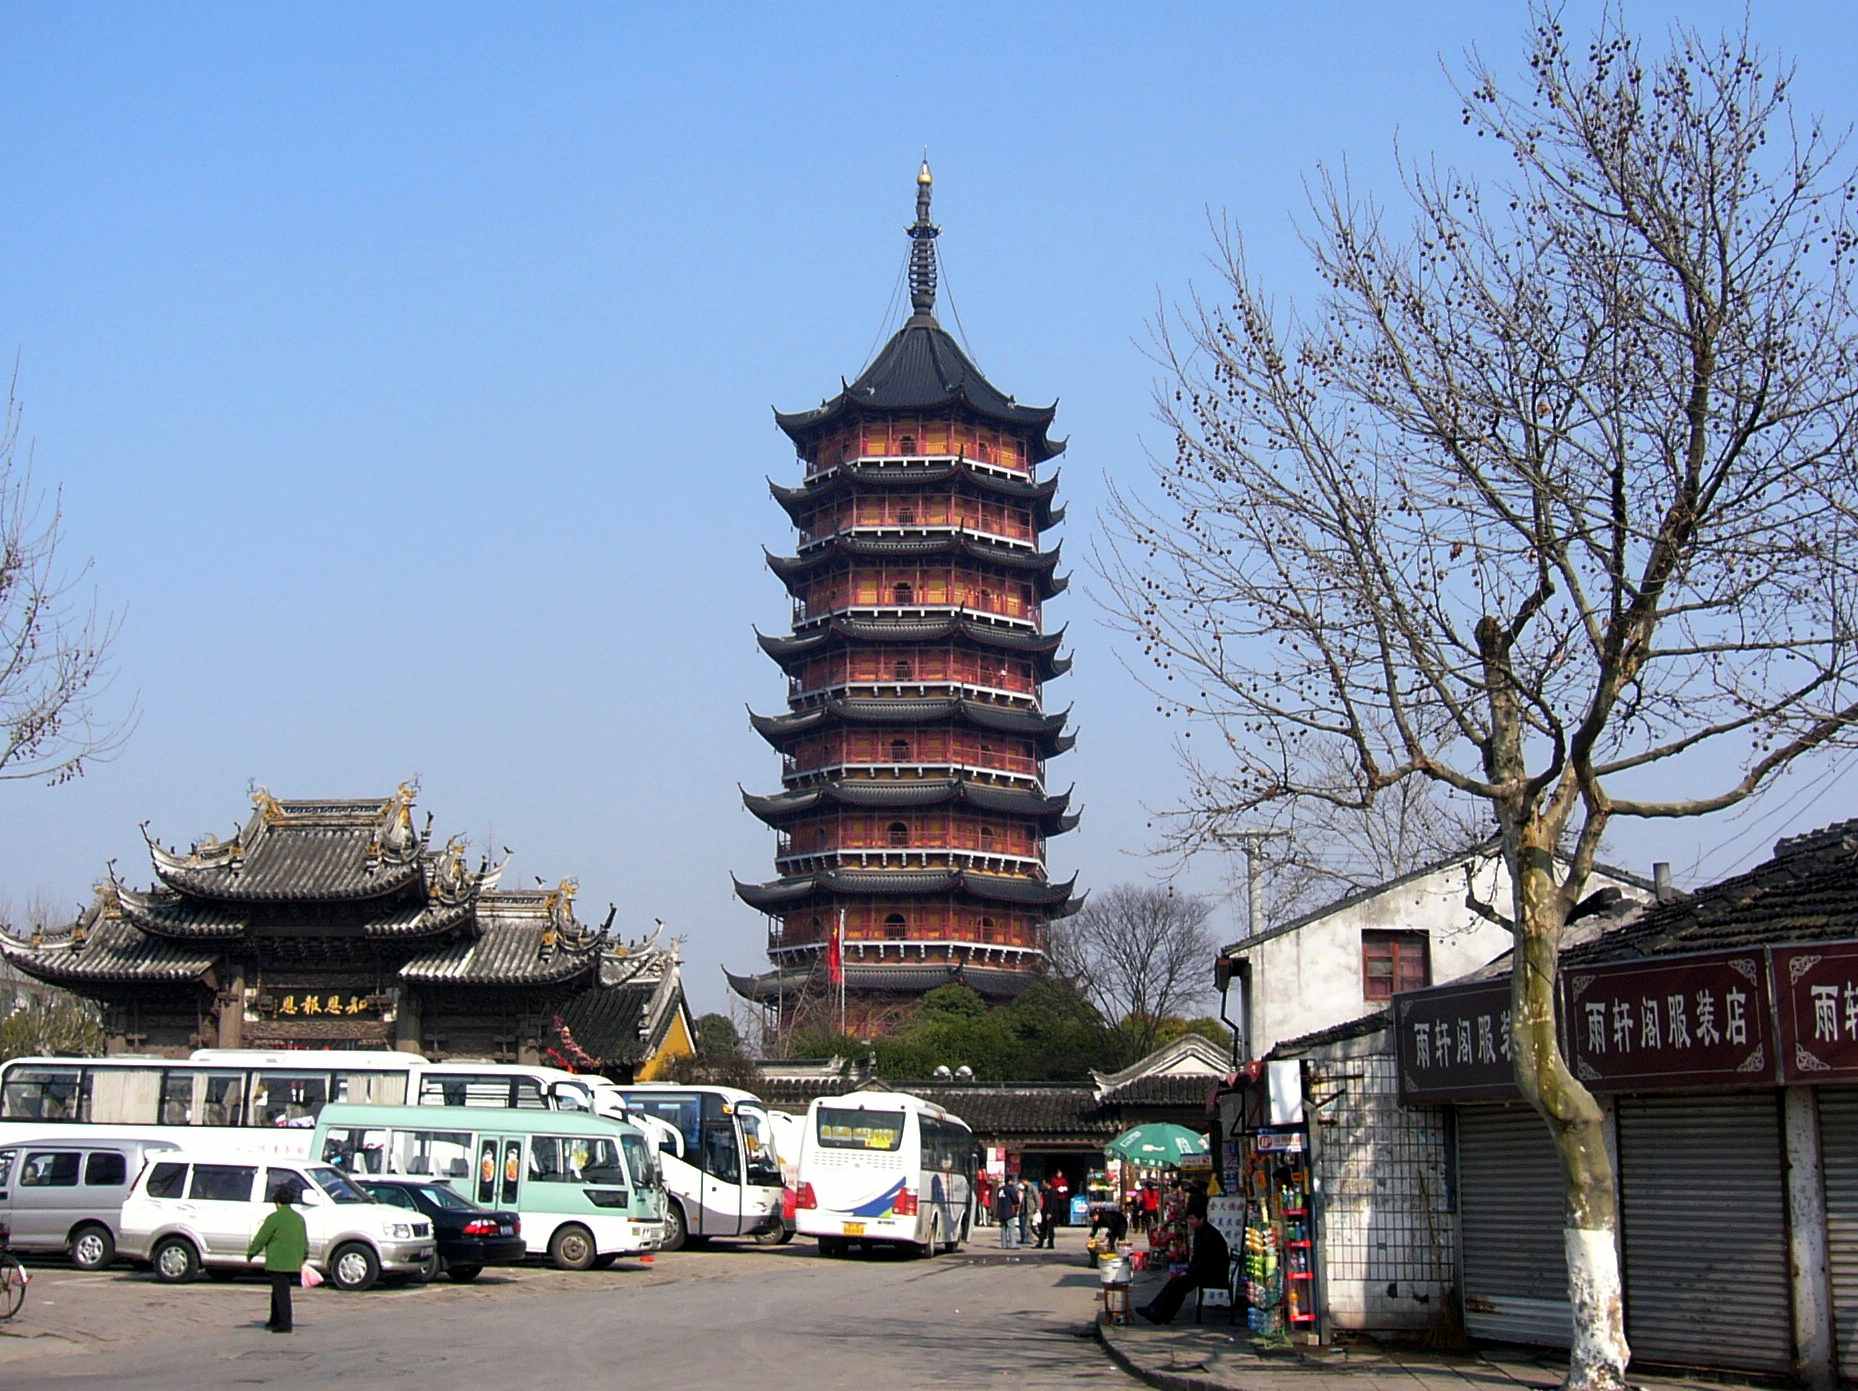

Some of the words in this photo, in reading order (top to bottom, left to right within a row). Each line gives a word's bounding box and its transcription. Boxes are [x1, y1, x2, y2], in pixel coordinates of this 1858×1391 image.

[1585, 985, 1746, 1055] 雨轩阁服装店
